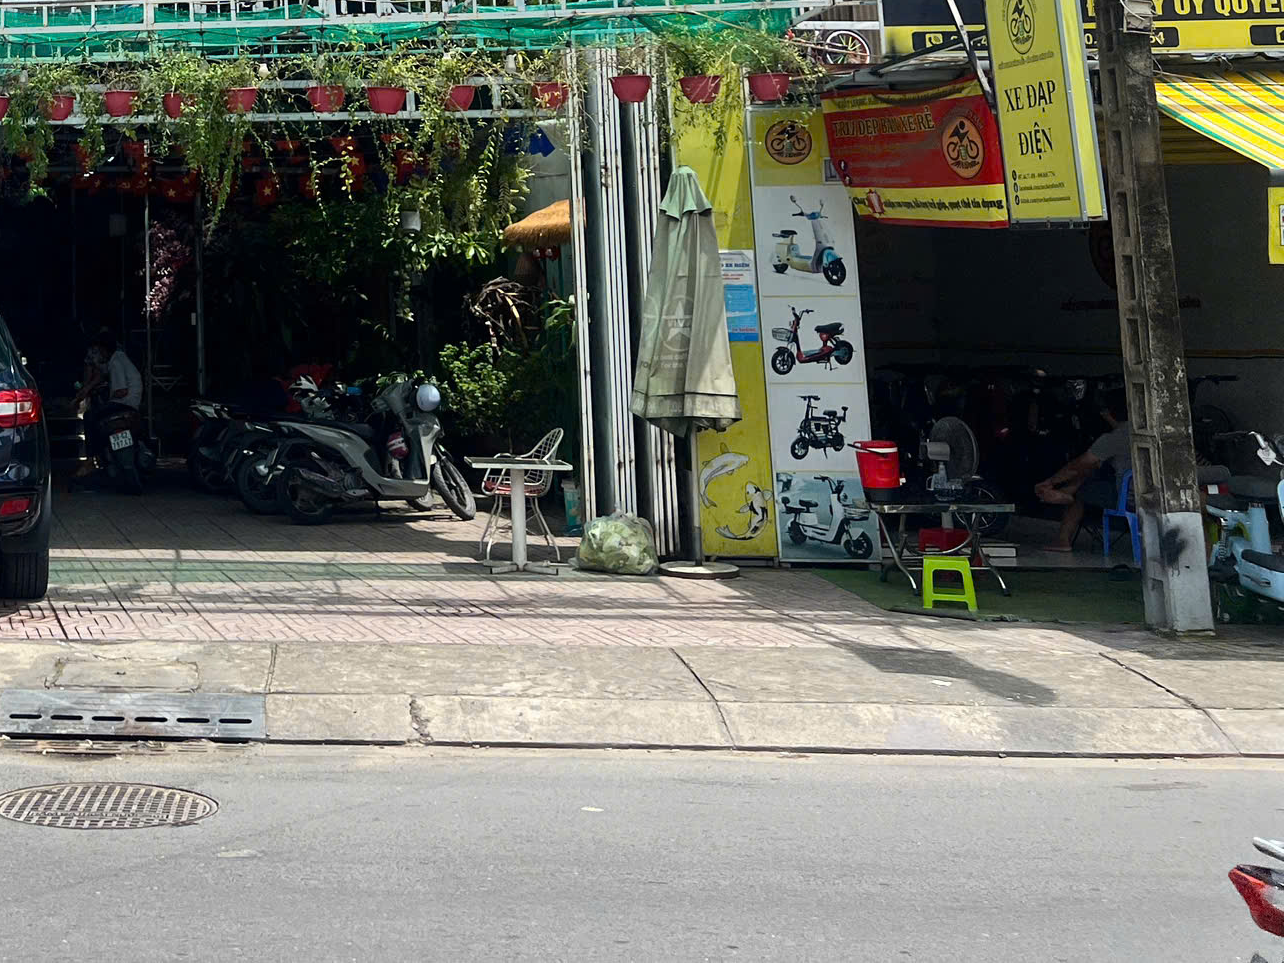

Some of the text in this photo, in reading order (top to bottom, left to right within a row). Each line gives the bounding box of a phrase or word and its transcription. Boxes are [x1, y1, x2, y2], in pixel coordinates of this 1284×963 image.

[1004, 86, 1024, 112] XE
[1026, 80, 1056, 113] ĐẠP
[1018, 122, 1054, 160] ĐIỆN
